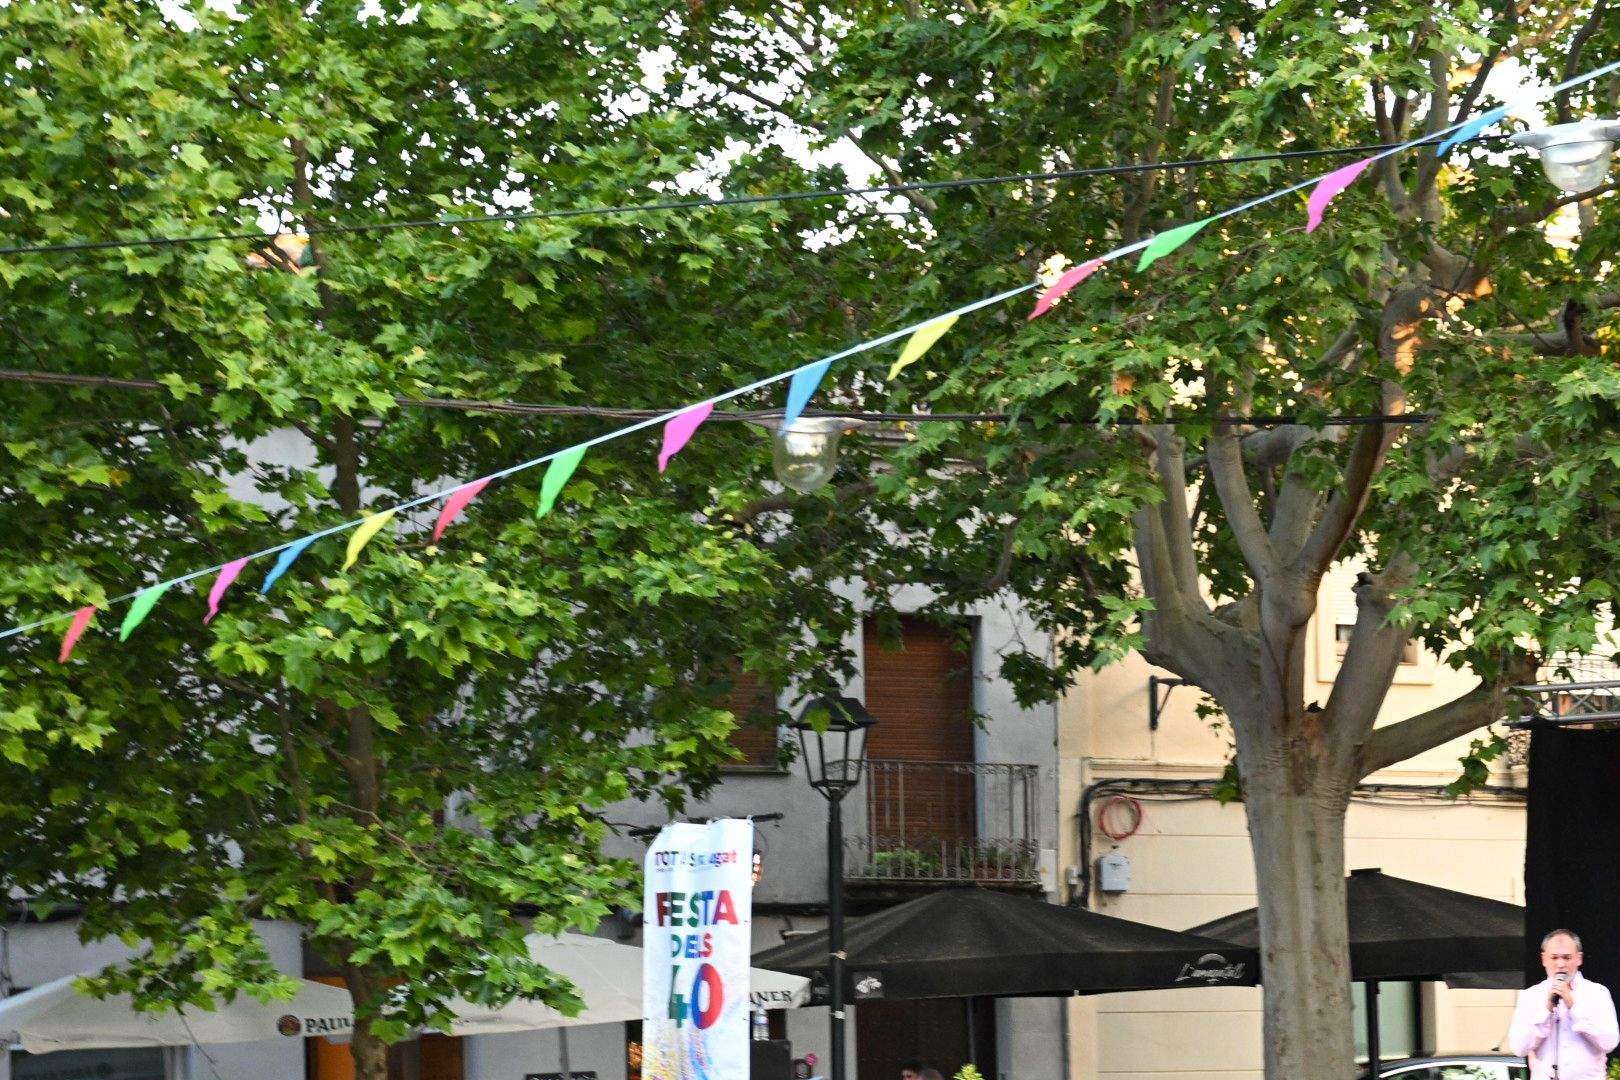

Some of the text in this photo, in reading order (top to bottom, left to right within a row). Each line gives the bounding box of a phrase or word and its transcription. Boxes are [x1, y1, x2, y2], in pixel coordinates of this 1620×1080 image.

[656, 889, 739, 928] FESTA
[671, 933, 712, 958] DES
[669, 963, 725, 1030] 40
[304, 1016, 353, 1033] PAUL
